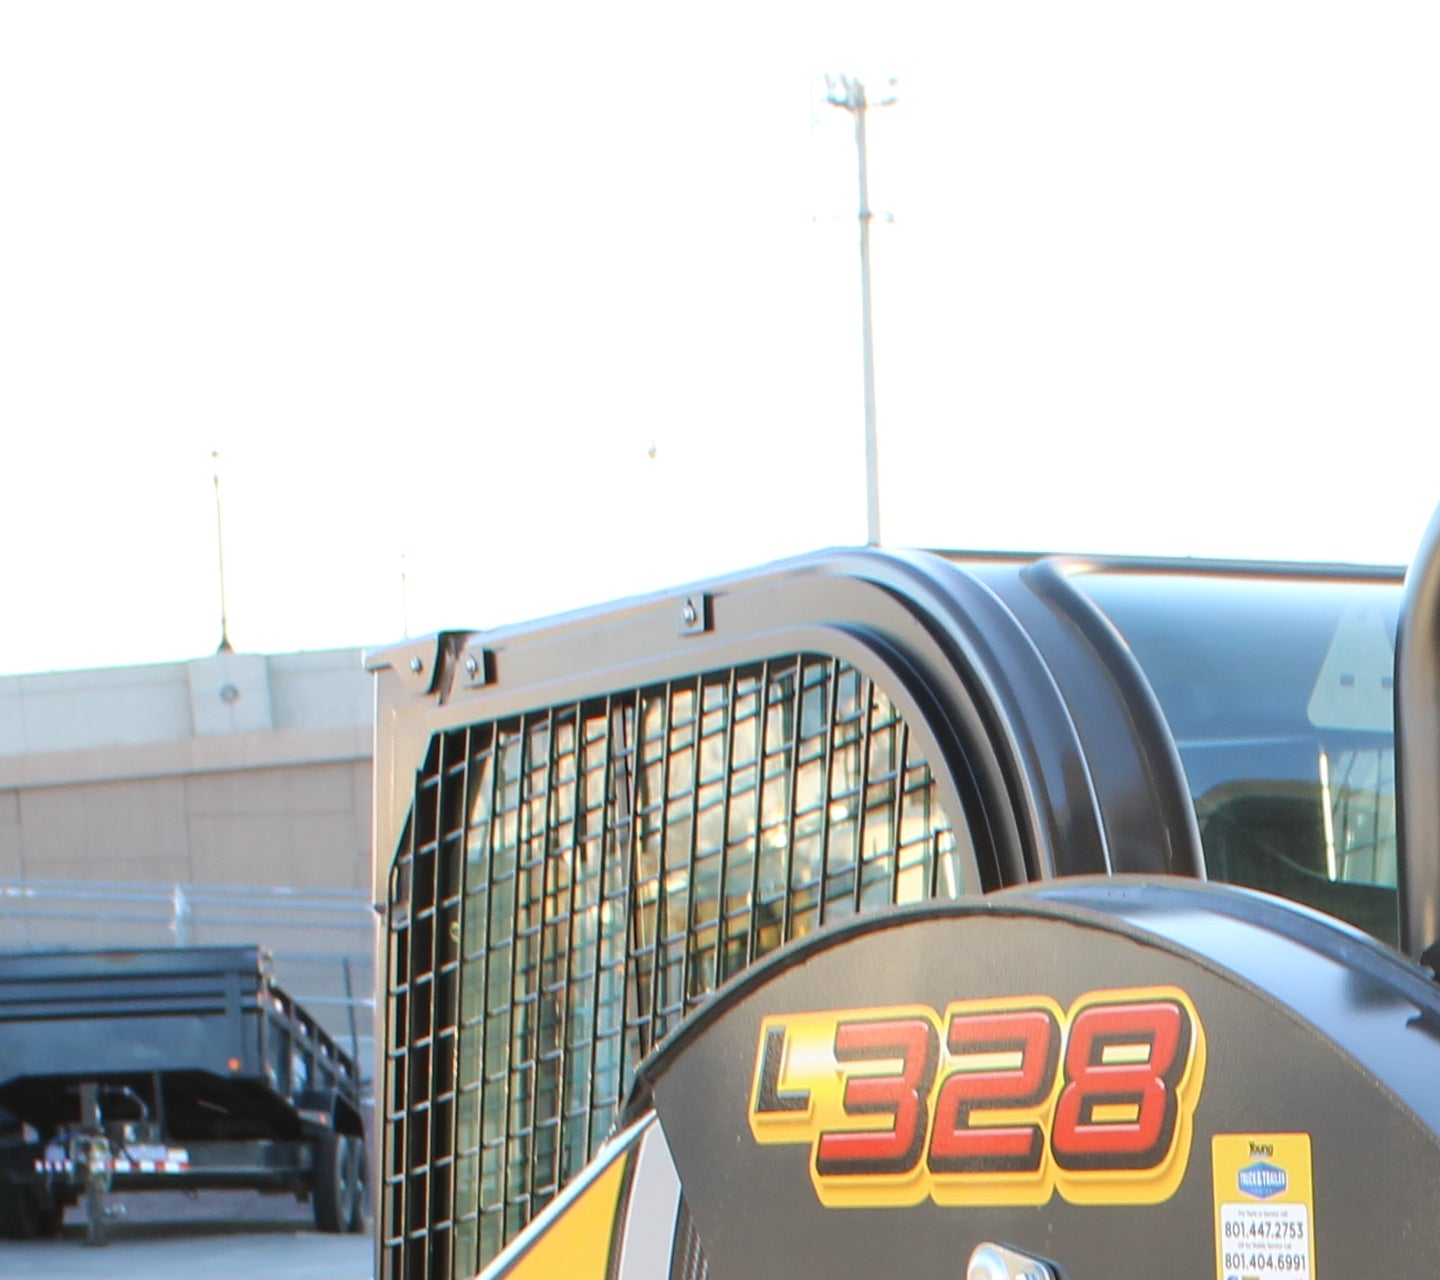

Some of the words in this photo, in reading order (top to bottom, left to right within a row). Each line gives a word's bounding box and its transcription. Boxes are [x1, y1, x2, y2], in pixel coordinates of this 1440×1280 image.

[753, 996, 1196, 1178] L328
[1248, 1140, 1274, 1158] Young
[1224, 1221, 1304, 1239] 801.447.2753
[1224, 1252, 1306, 1271] 801.404.6991
